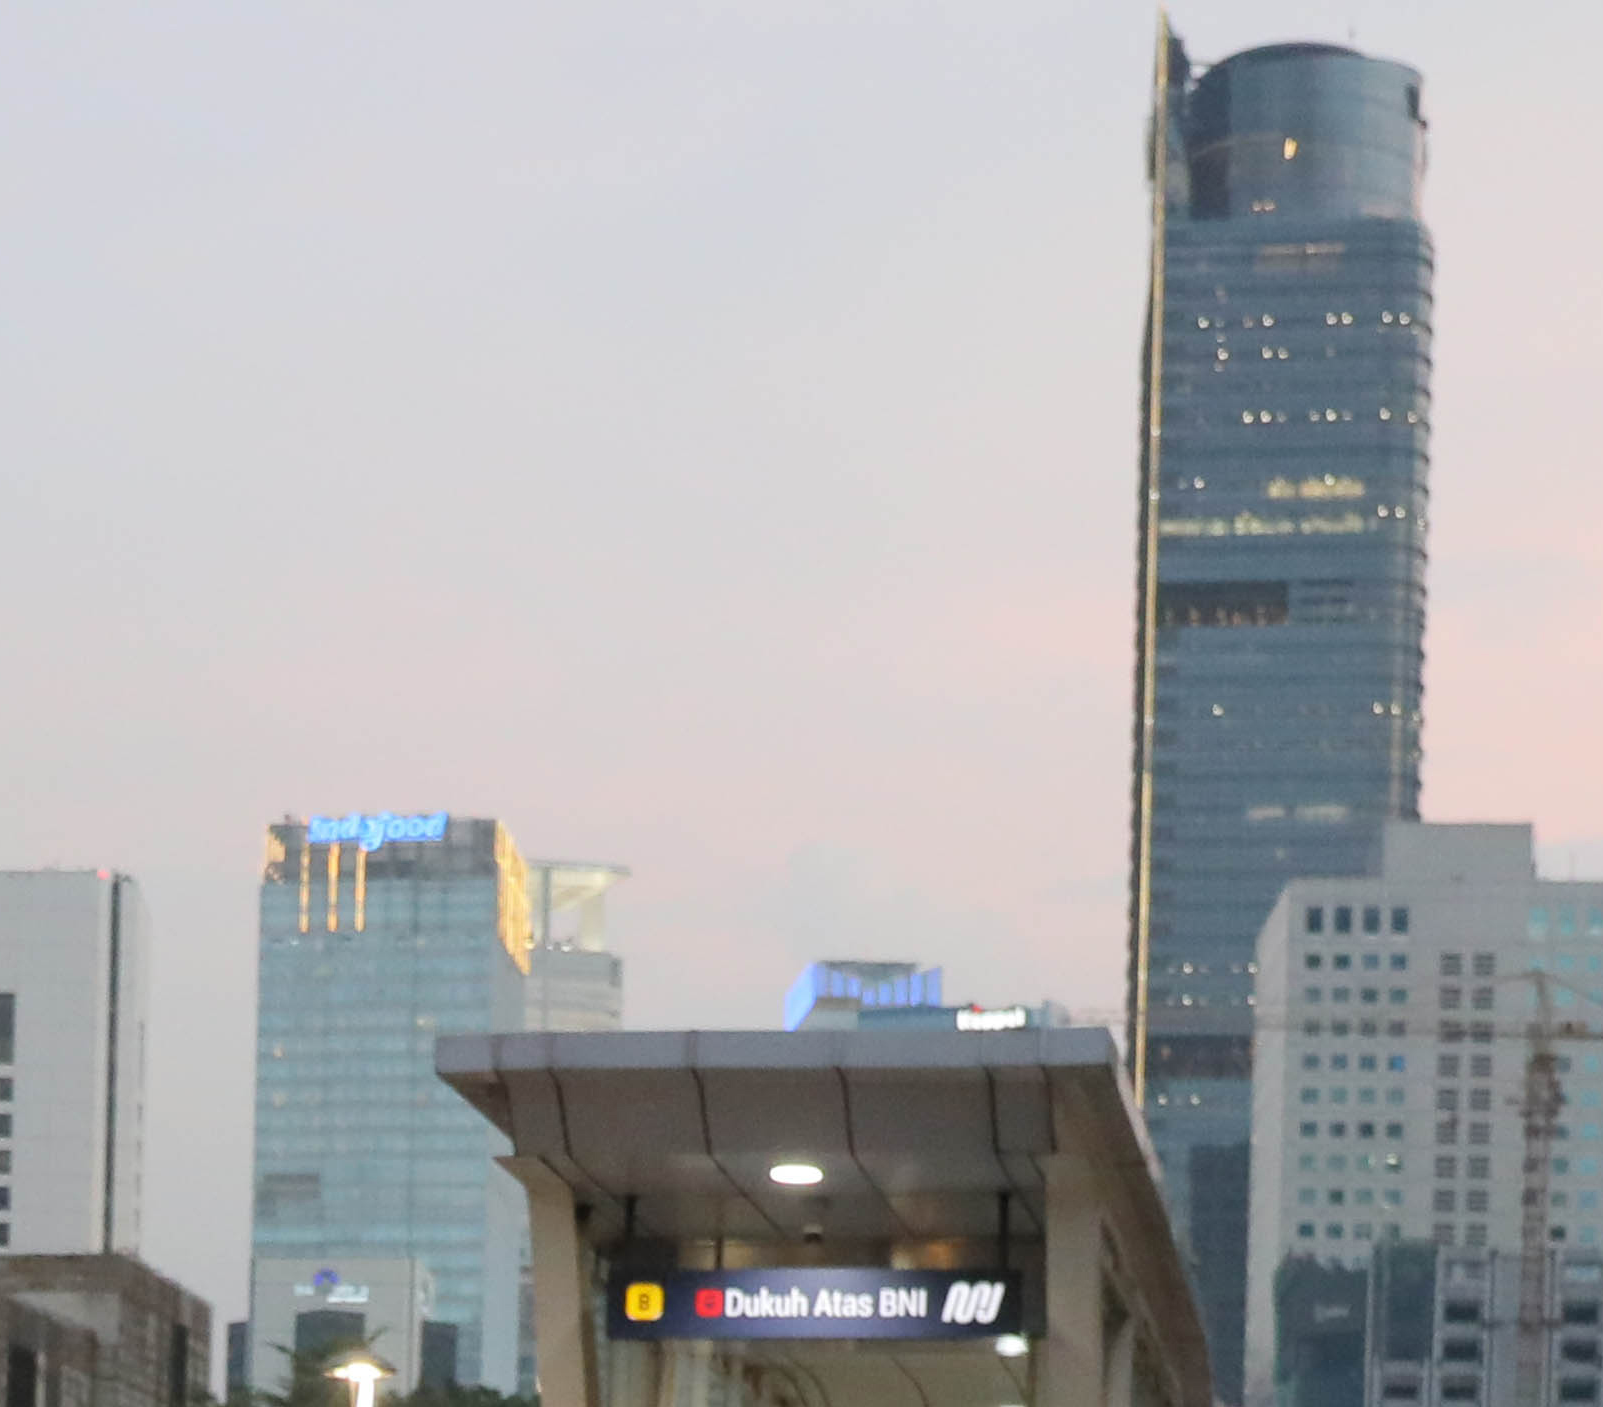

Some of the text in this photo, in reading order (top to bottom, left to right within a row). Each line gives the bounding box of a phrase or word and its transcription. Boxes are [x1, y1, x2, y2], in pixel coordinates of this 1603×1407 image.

[724, 1287, 928, 1318] Dukuh Atas BNI
